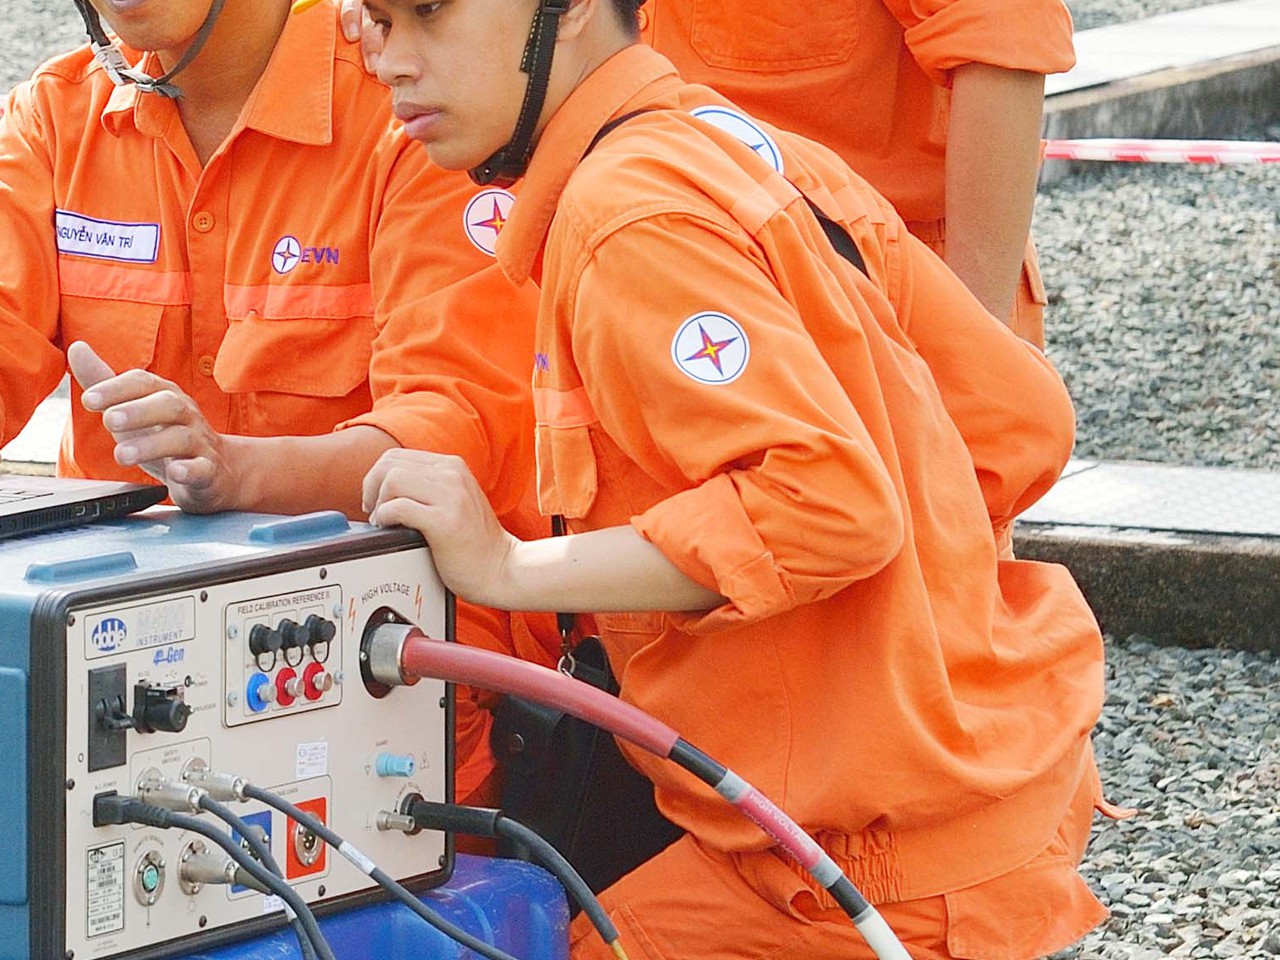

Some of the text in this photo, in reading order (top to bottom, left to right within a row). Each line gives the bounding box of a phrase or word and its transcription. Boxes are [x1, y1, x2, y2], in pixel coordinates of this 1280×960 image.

[119, 235, 135, 249] TRÍ
[301, 246, 339, 265] EVN
[361, 582, 410, 604] HIGH VOLTAGE
[237, 605, 253, 615] FIELD
[255, 599, 291, 612] CALIBRATION
[293, 592, 325, 605] REFERENCE
[136, 630, 183, 647] INSTRUMENT
